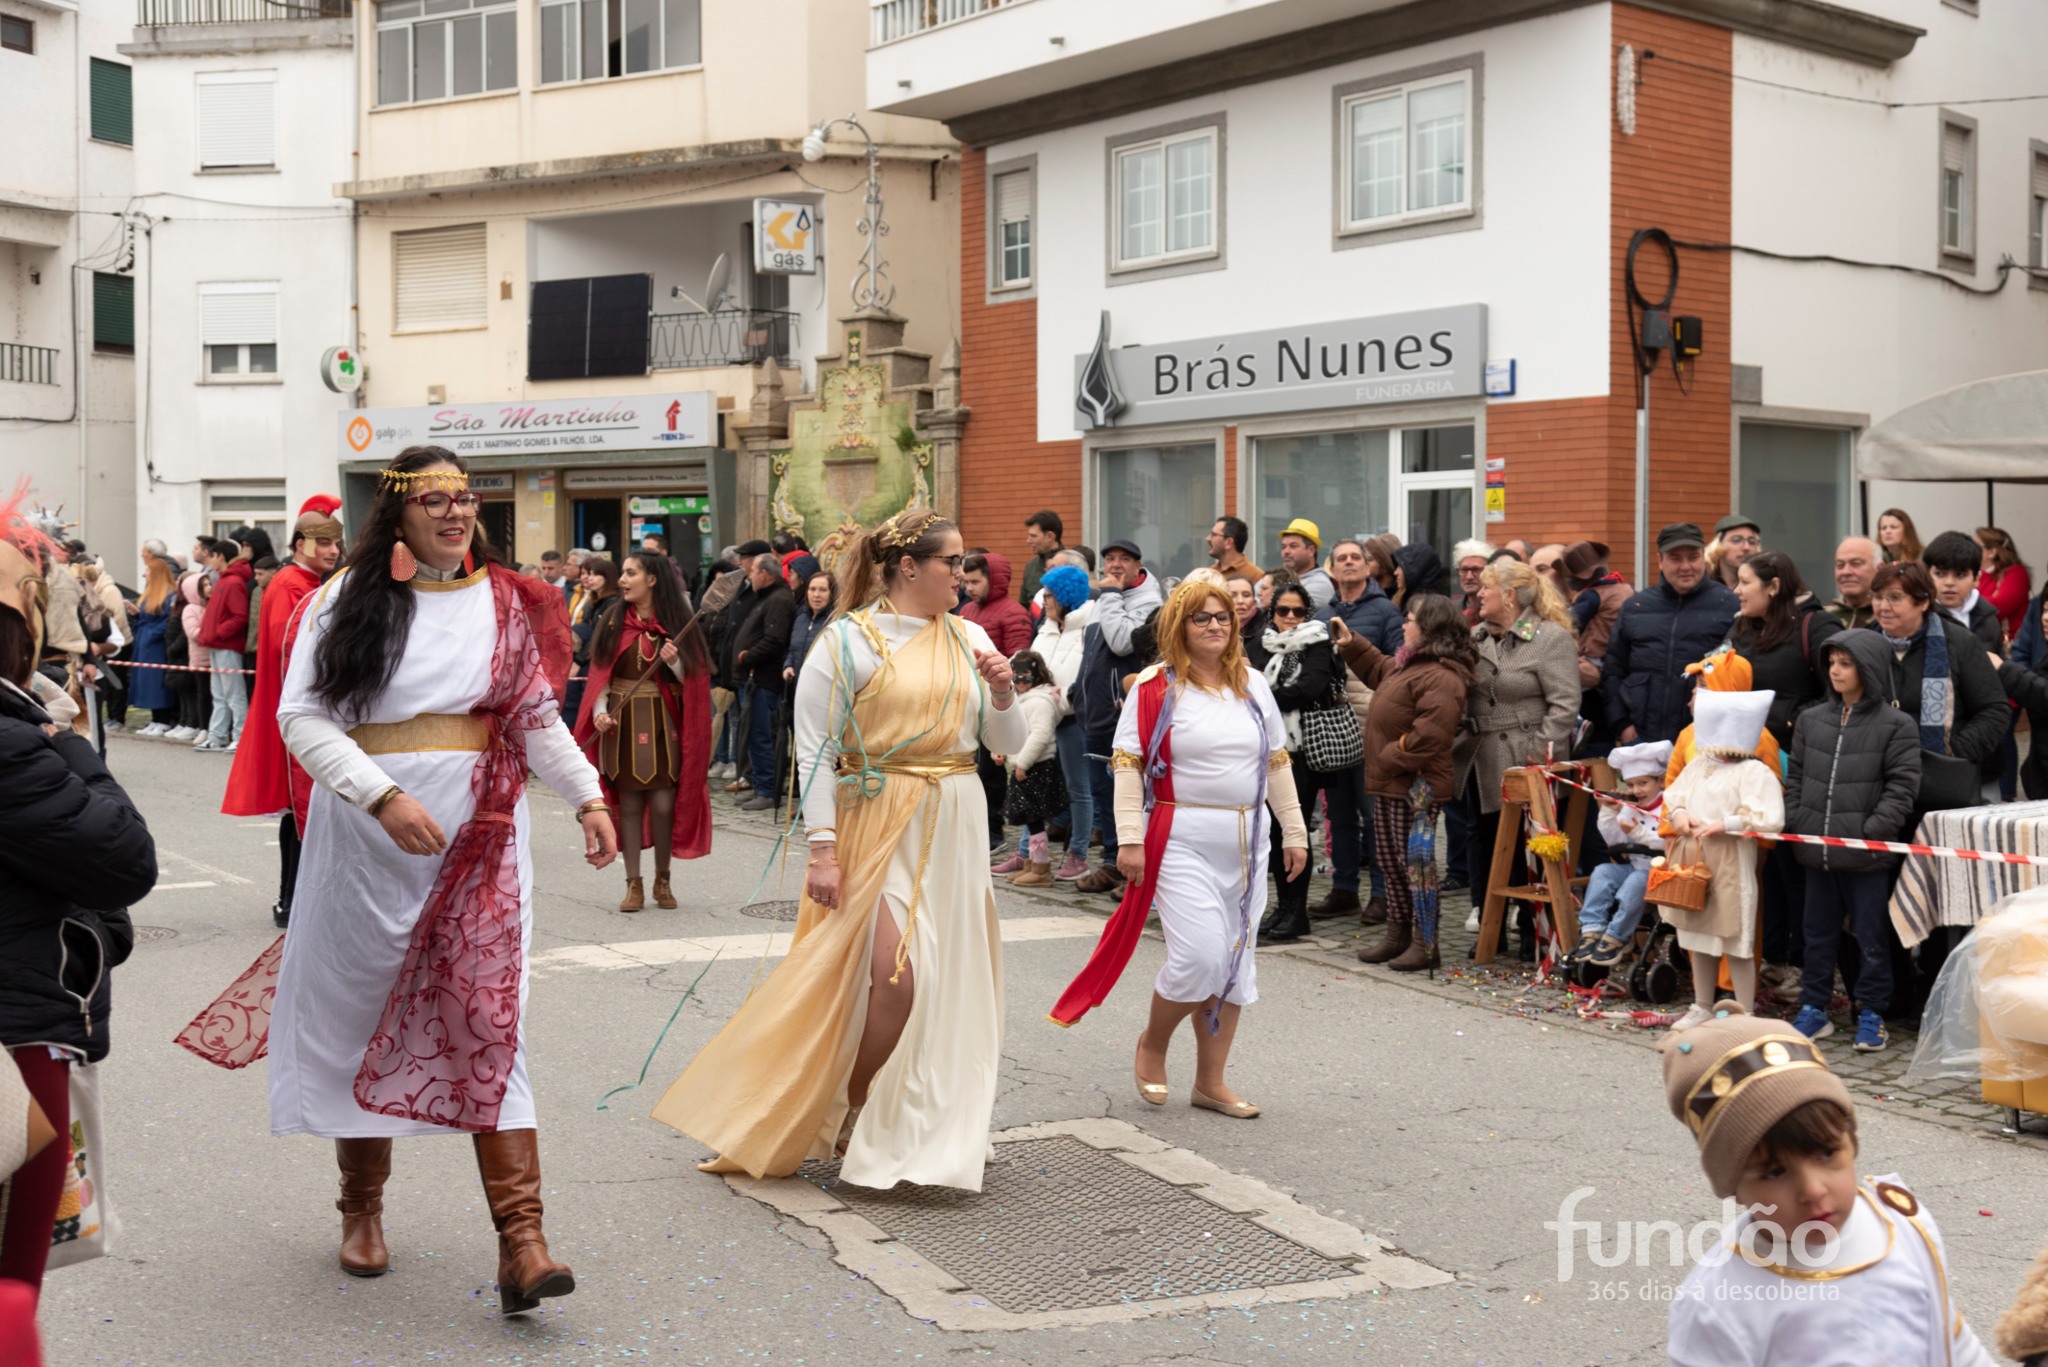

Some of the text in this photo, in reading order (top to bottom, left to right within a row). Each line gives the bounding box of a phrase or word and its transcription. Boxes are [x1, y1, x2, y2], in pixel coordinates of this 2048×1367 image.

[1154, 330, 1454, 396] Brás Nunes
[1356, 378, 1455, 400] FUNERÁRIA
[429, 399, 638, 431] São Martinho
[375, 426, 397, 440] galp
[660, 432, 678, 440] TIEN
[457, 439, 475, 450] JOSÉ
[484, 438, 522, 449] MARTINHO
[524, 437, 550, 447] GOMES
[552, 436, 558, 445] &
[468, 477, 504, 488] UNDIG
